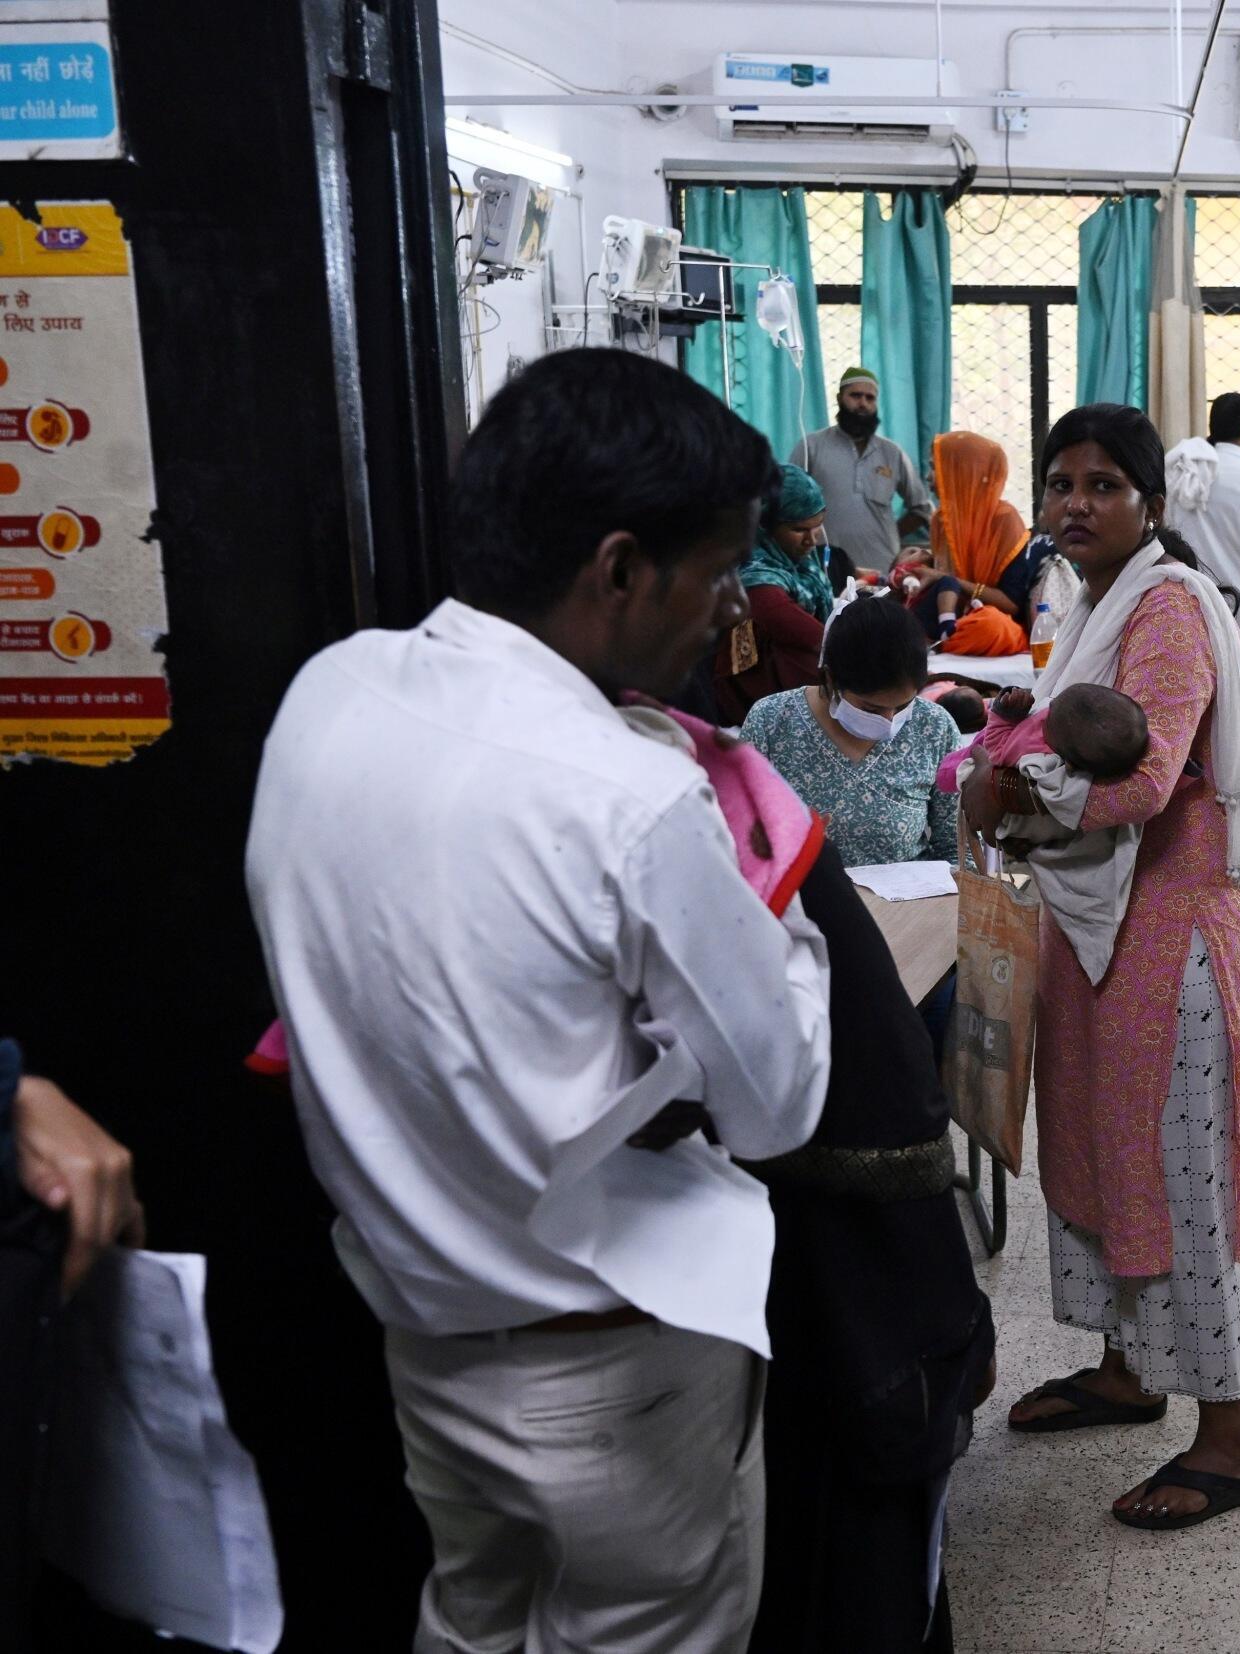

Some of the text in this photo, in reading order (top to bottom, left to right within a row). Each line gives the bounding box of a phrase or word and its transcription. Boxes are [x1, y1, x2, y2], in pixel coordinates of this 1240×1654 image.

[18, 56, 50, 82] नहीं
[0, 99, 97, 120] ur child alone
[4, 312, 84, 333] लिए उपाय
